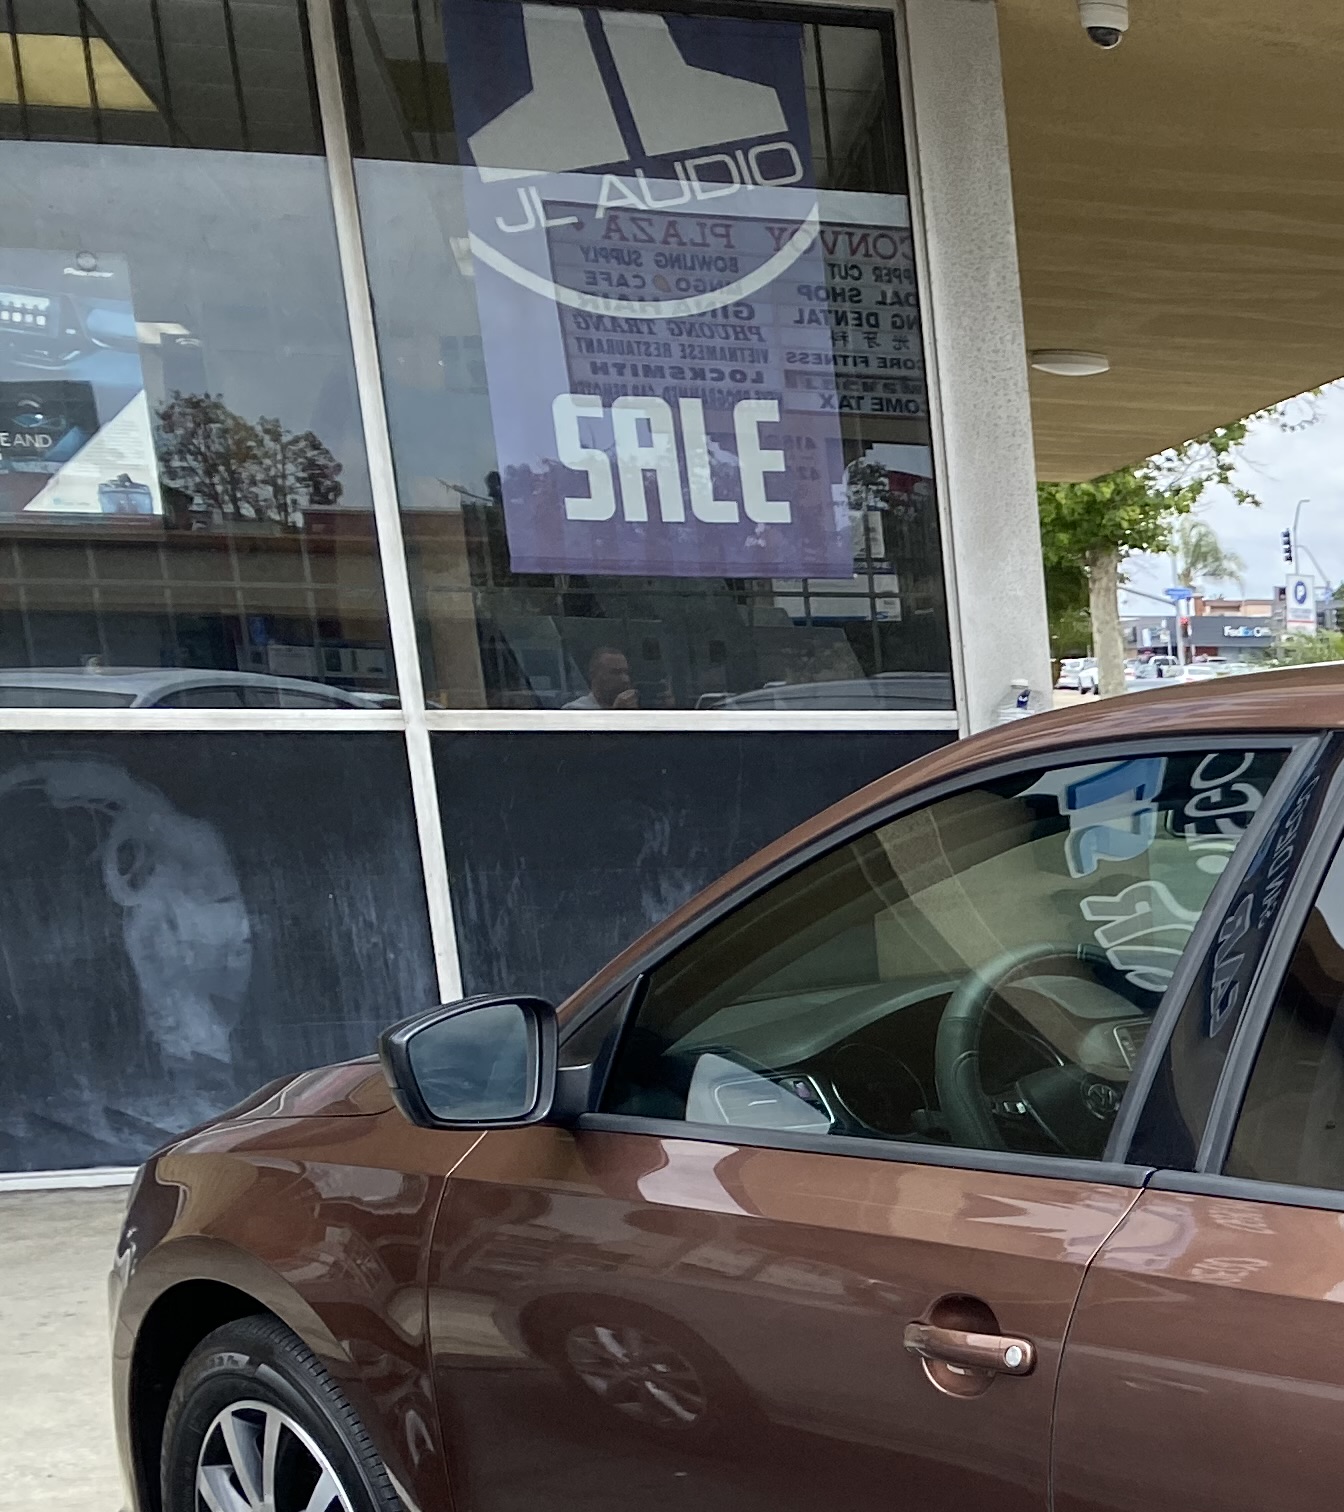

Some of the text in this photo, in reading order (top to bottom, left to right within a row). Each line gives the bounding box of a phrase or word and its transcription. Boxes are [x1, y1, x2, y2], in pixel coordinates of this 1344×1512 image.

[496, 141, 804, 233] JL AUDIO
[13, 433, 53, 448] AND
[551, 393, 792, 525] SALE
